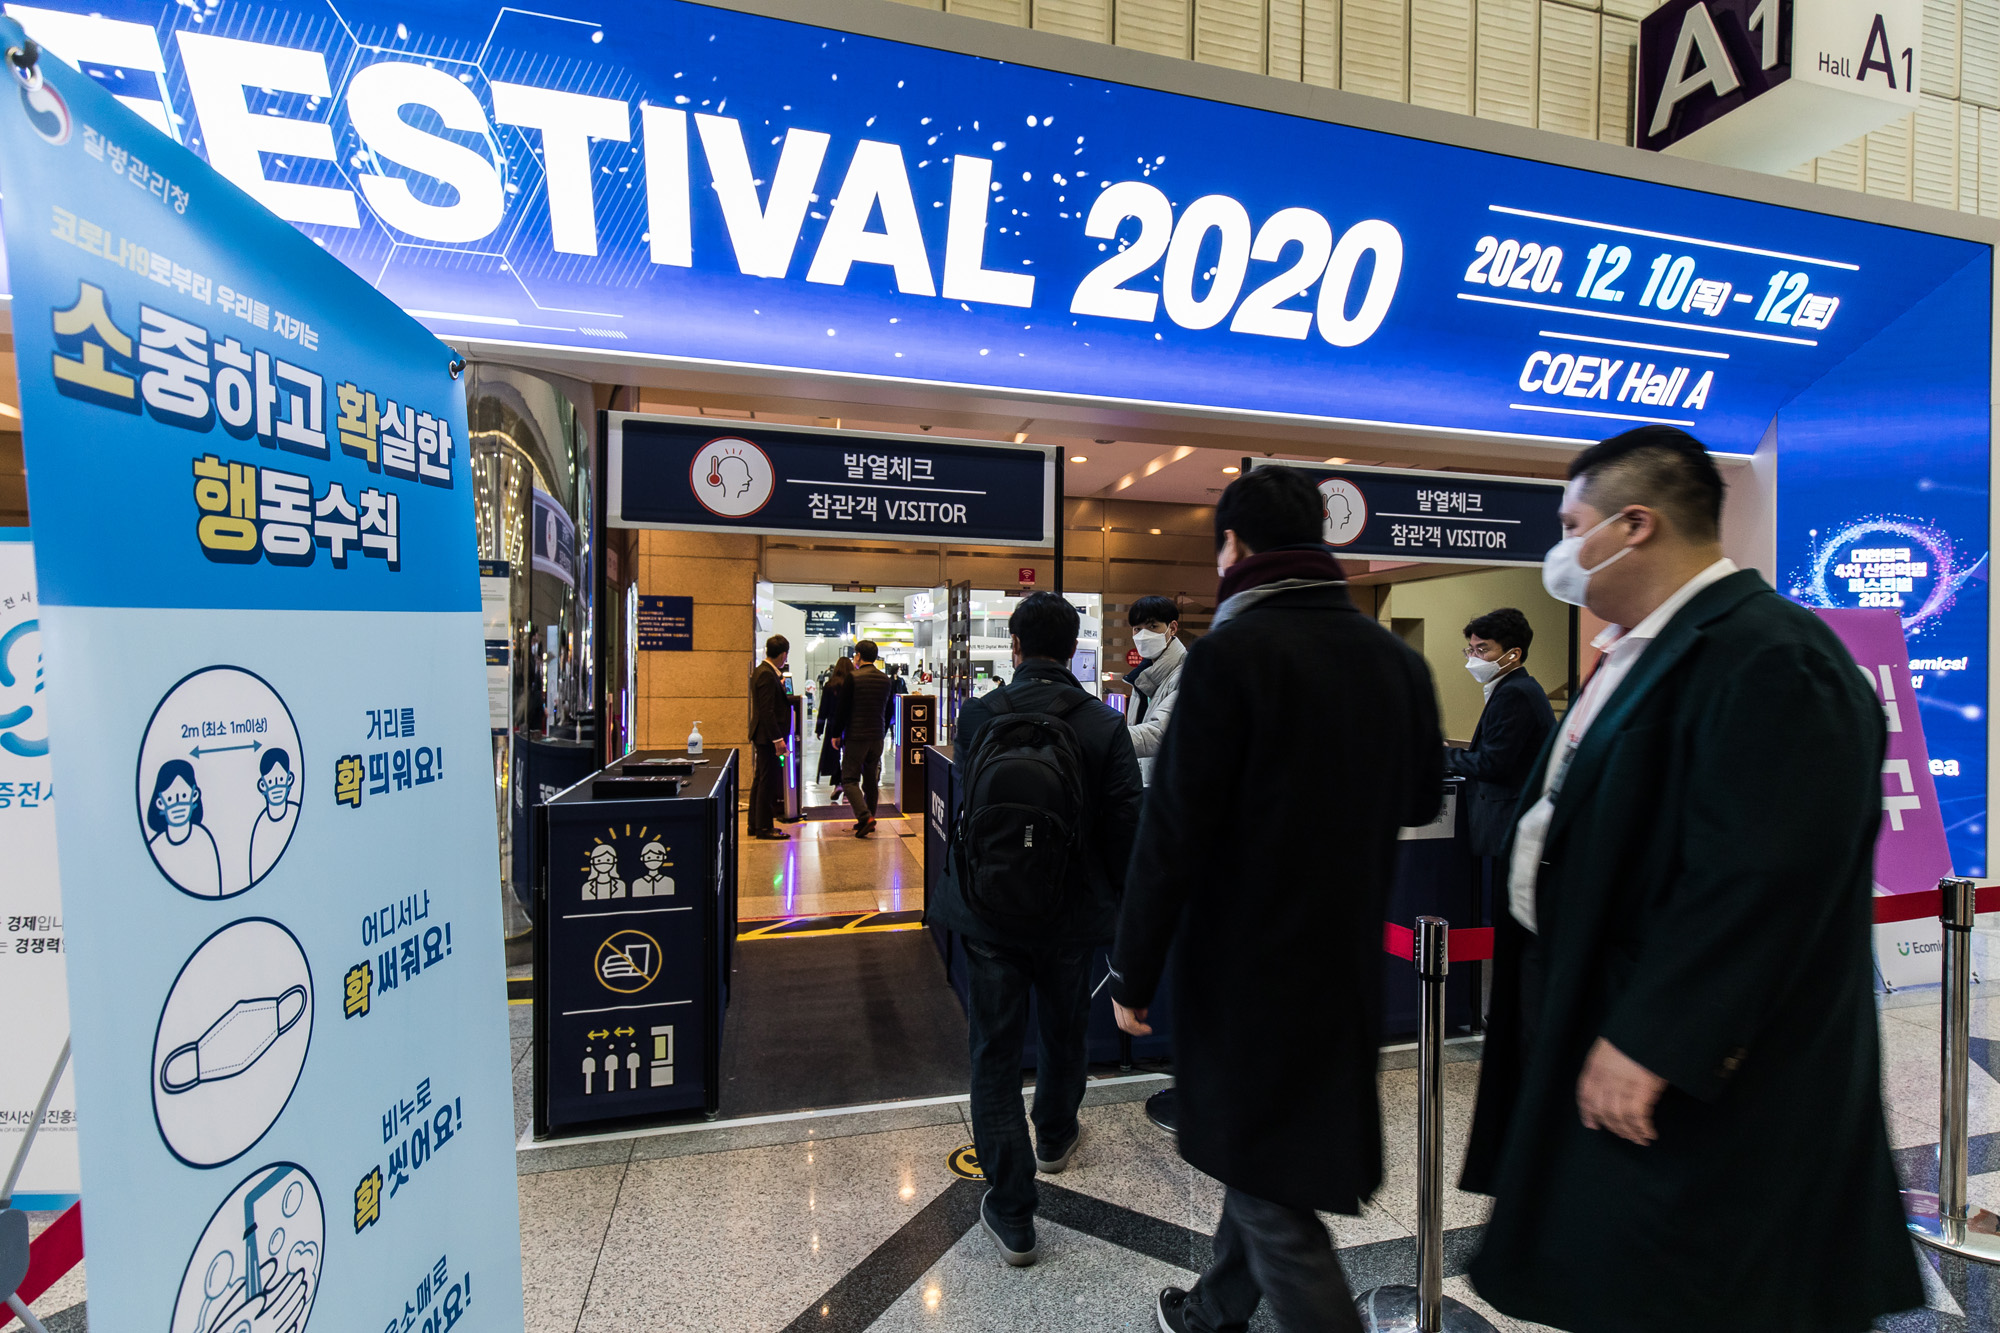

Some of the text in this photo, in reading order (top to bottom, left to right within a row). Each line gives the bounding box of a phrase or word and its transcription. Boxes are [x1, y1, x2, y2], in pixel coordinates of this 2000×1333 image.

[1649, 0, 1779, 137] A1
[1818, 13, 1913, 93] Hall A1
[83, 124, 189, 214] 질병관리청
[51, 205, 319, 351] 코로나19로부터 우리를 지키는
[1070, 181, 1404, 347] 2020
[1464, 236, 1563, 293] 2020.
[1576, 243, 1632, 302] 12.
[52, 281, 453, 486] 소중하고 확실한
[1518, 350, 1714, 410] COEX Hall A
[843, 453, 935, 482] 발열체크
[193, 453, 399, 567] 행동수칙
[808, 493, 967, 524] 참관객 VISITOR
[1416, 489, 1483, 514] 발열체크
[1391, 523, 1507, 549] 참관객 VISITOR
[1858, 592, 1900, 607] 2021
[1908, 656, 1969, 671] amics!
[181, 717, 268, 738] 2m (최소 1m이상)
[366, 707, 415, 740] 거리를
[336, 747, 443, 808] 확 띄워요!
[362, 889, 430, 946] 어디서나
[1912, 940, 1943, 954] Ecomi
[344, 922, 451, 1018] 확 써줘요!
[0, 1110, 77, 1124] 전시산진흥
[382, 1077, 432, 1144] 비누로
[355, 1096, 462, 1233] 확 씻어요!
